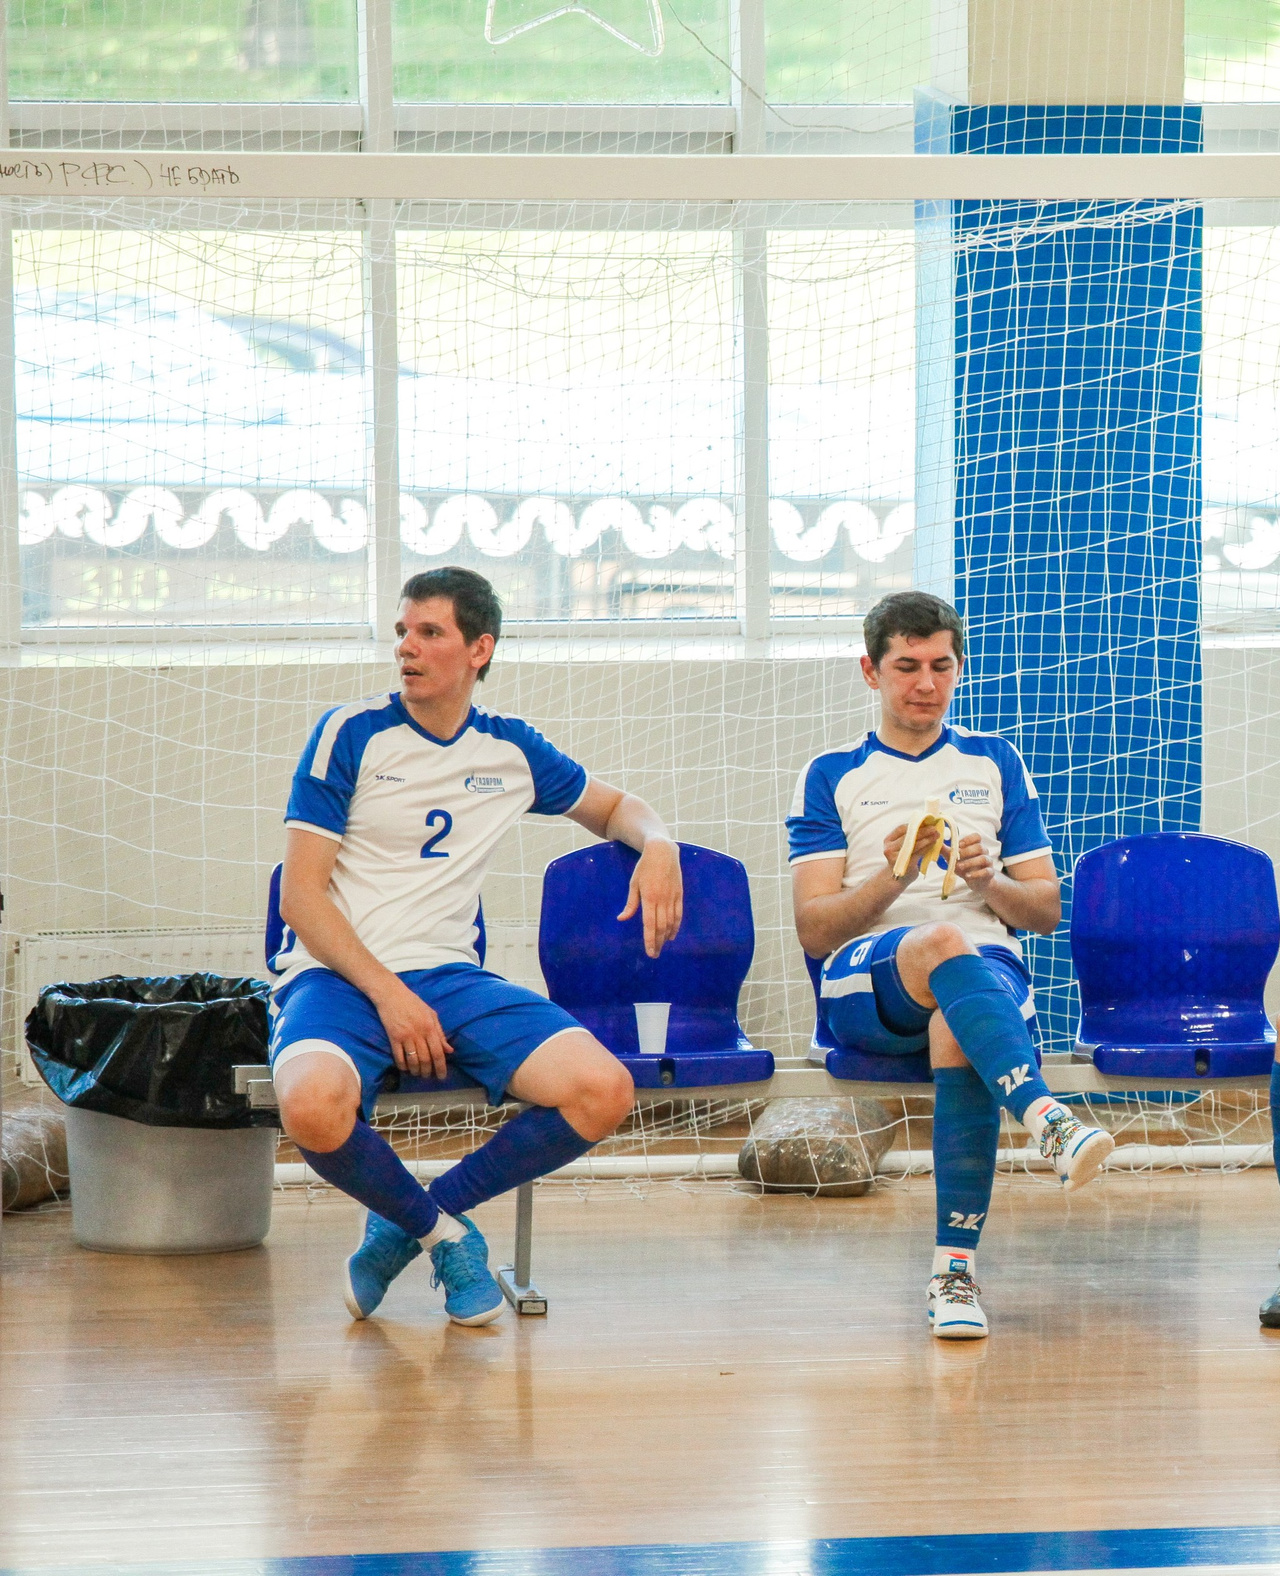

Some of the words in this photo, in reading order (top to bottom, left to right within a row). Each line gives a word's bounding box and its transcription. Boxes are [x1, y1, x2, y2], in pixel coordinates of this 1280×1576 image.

[961, 789, 989, 798] ГАЗПРОМ
[420, 809, 453, 859] 2
[997, 1063, 1034, 1097] 2K
[948, 1211, 986, 1231] 2K
